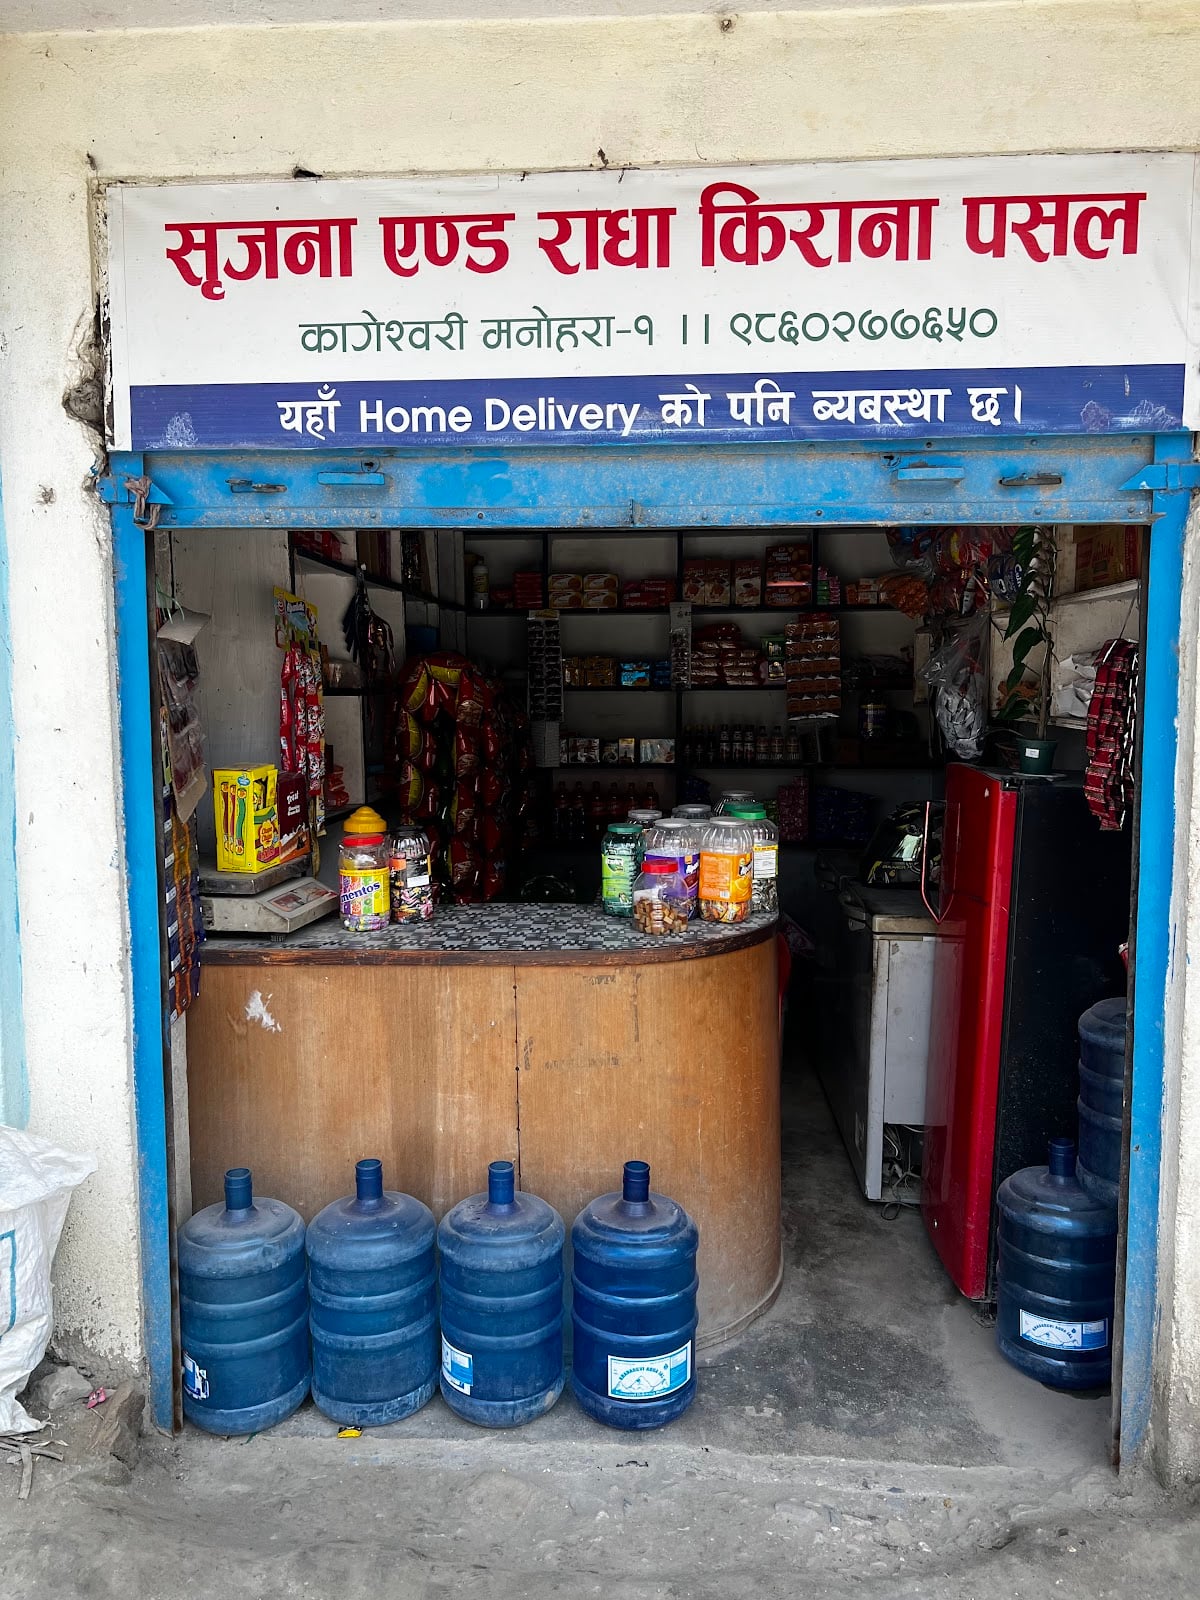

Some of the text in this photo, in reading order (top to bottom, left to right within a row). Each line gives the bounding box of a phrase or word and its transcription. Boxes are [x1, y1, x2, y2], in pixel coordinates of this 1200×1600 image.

[165, 182, 1146, 300] सृजना एण्ड राधा किराना पसल
[299, 310, 467, 352] कागेश्वरी
[729, 308, 998, 345] ९८६०२७७६५०
[277, 384, 341, 440] यहाँ
[360, 400, 473, 433] Home
[486, 398, 640, 436] Delivery
[659, 384, 711, 428] को
[726, 379, 796, 426] पनि
[812, 388, 952, 427] ब्यबस्था
[341, 882, 380, 902] mentos
